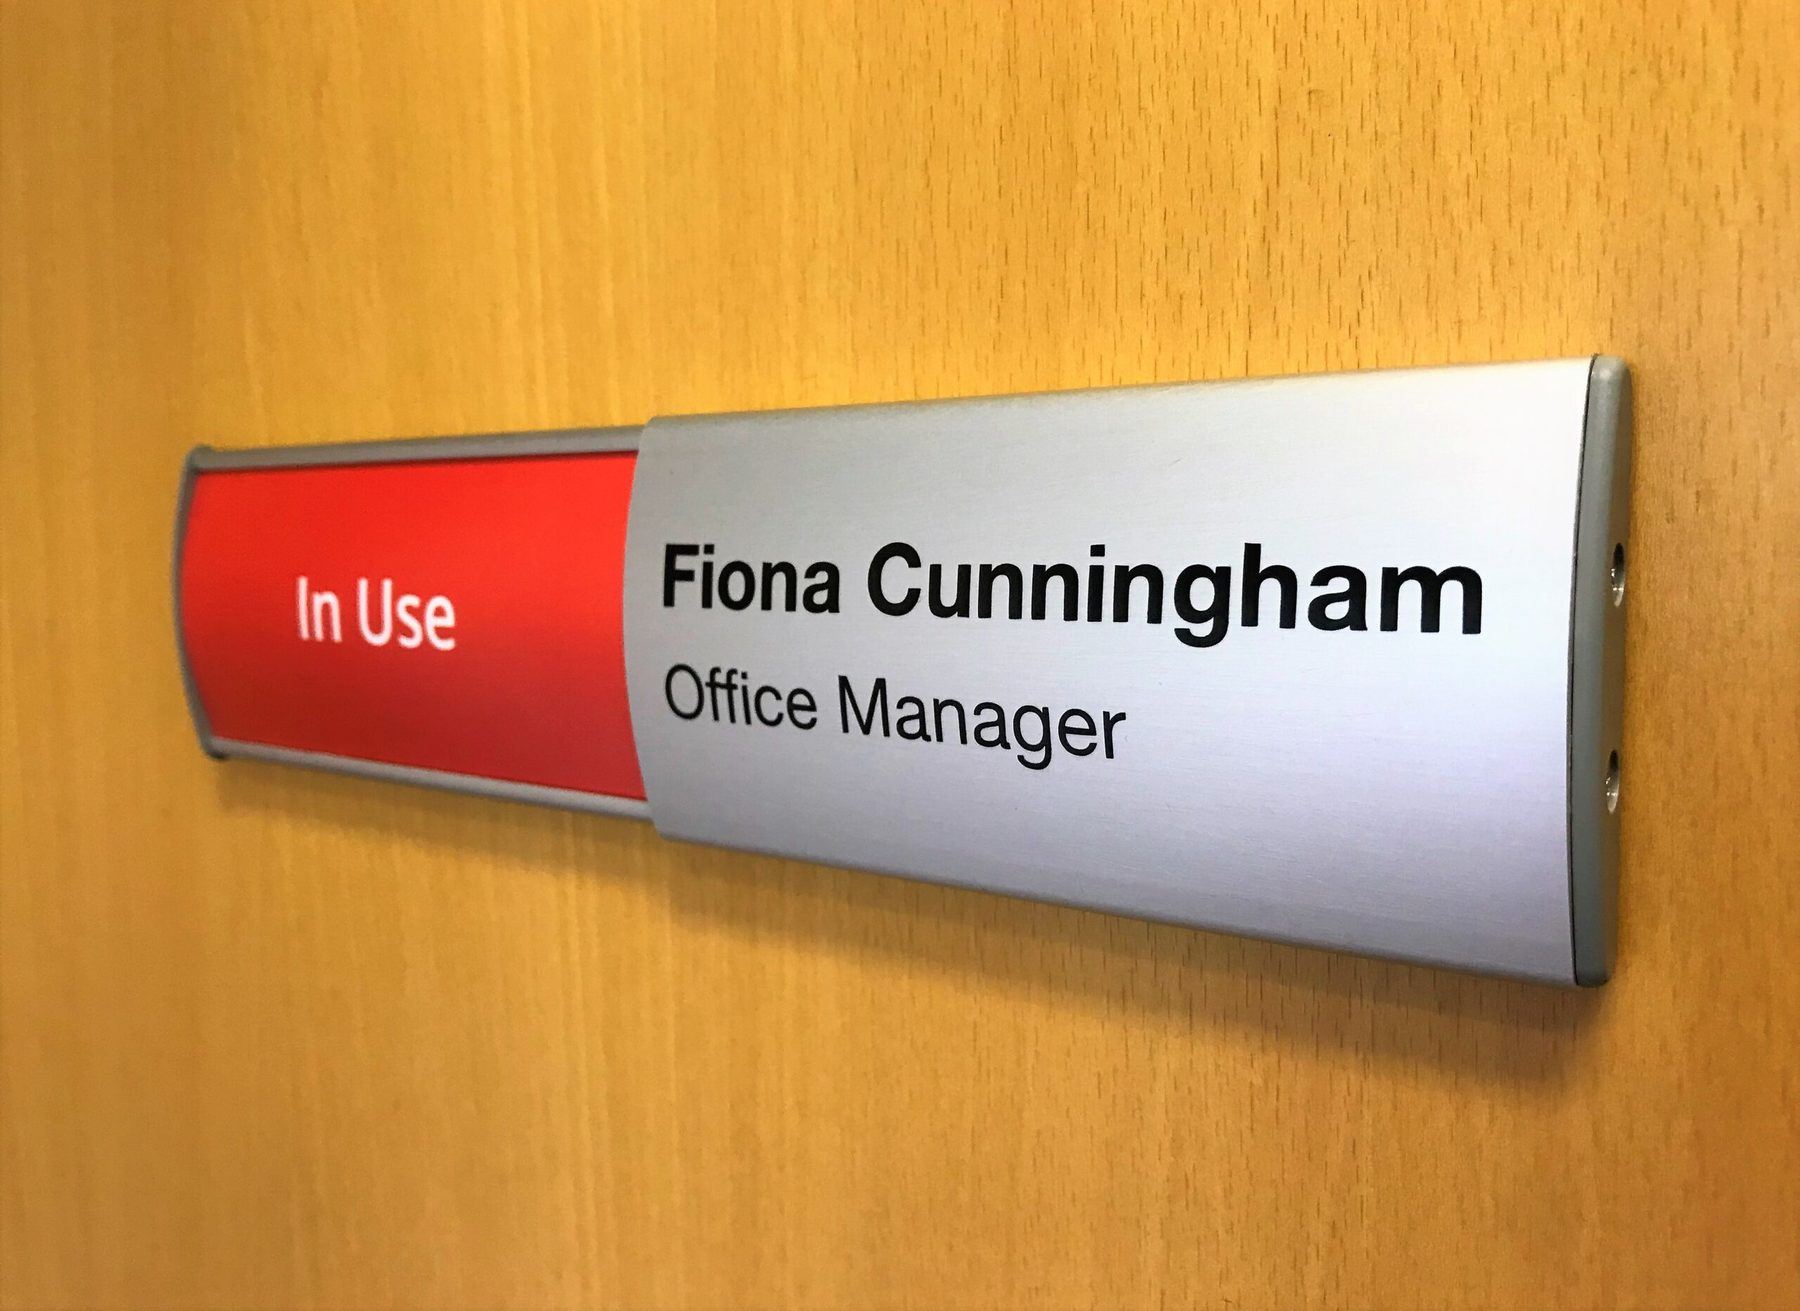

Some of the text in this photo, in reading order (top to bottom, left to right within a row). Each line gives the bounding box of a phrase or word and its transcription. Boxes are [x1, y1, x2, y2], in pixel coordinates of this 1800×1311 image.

[297, 576, 457, 652] In Use
[662, 541, 1483, 649] Fiona Cunningham
[664, 663, 1127, 771] Office Manager
